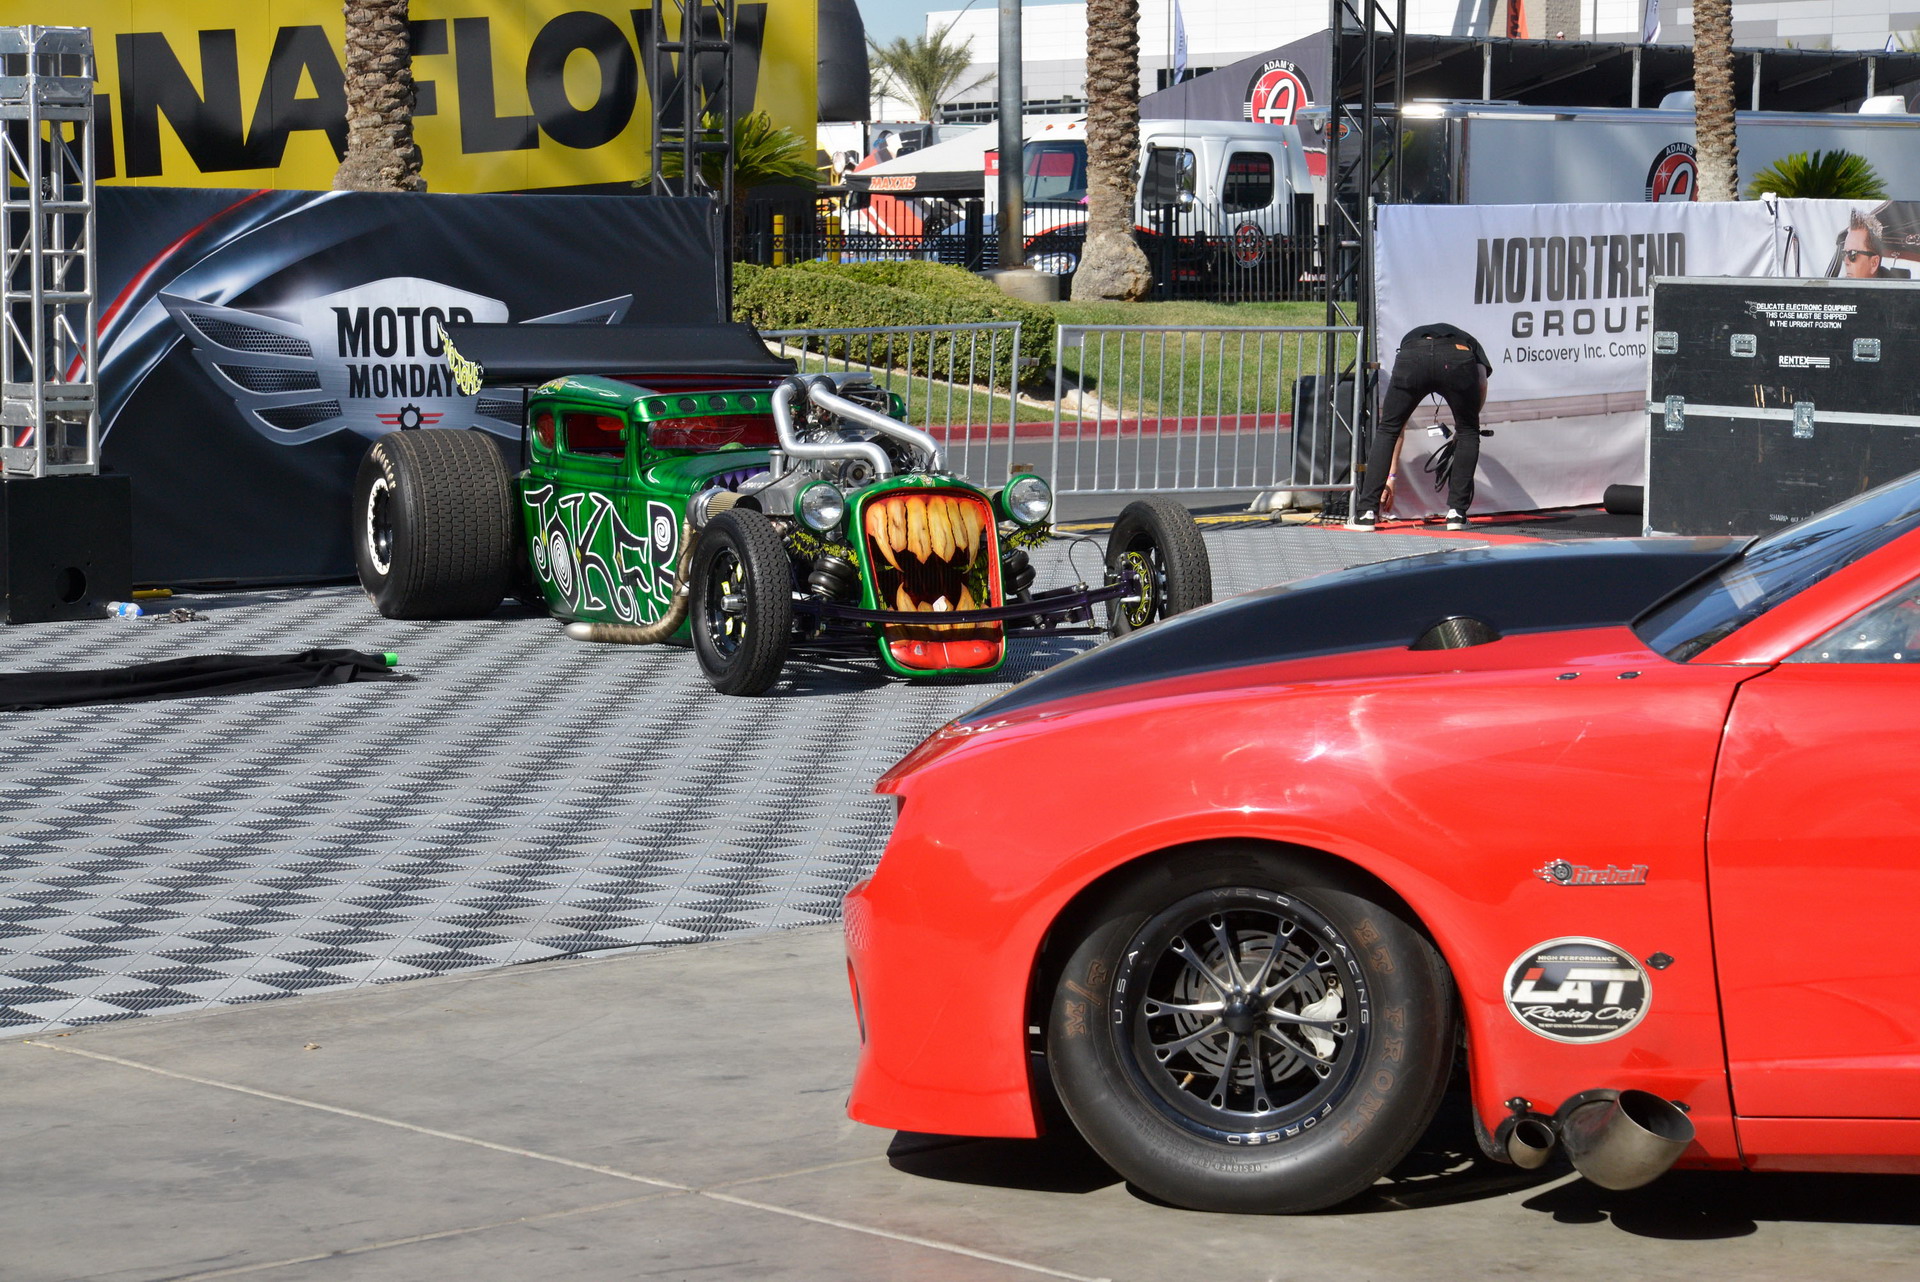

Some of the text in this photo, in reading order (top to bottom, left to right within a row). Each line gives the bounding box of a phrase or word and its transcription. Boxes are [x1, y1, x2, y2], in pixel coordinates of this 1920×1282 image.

[1263, 59, 1295, 73] ADAM'S
[1666, 143, 1694, 156] ADAM'S
[1474, 232, 1686, 304] MOTORTREND
[331, 306, 474, 358] MOTO
[1823, 313, 1847, 321] SHIPPED
[1503, 348, 1512, 363] A
[1517, 347, 1579, 362] Discovery
[1584, 343, 1605, 358] Inc.
[1779, 355, 1809, 364] RENTEX
[345, 364, 468, 398] MONDAY
[524, 485, 678, 626] JOKER
[1212, 888, 1369, 1025] WELD RACING
[1512, 968, 1640, 1005] LAT
[1522, 1005, 1637, 1023] Racing Oils
[1340, 1006, 1405, 1148] FRONT
[1227, 1102, 1332, 1145] FORGED
